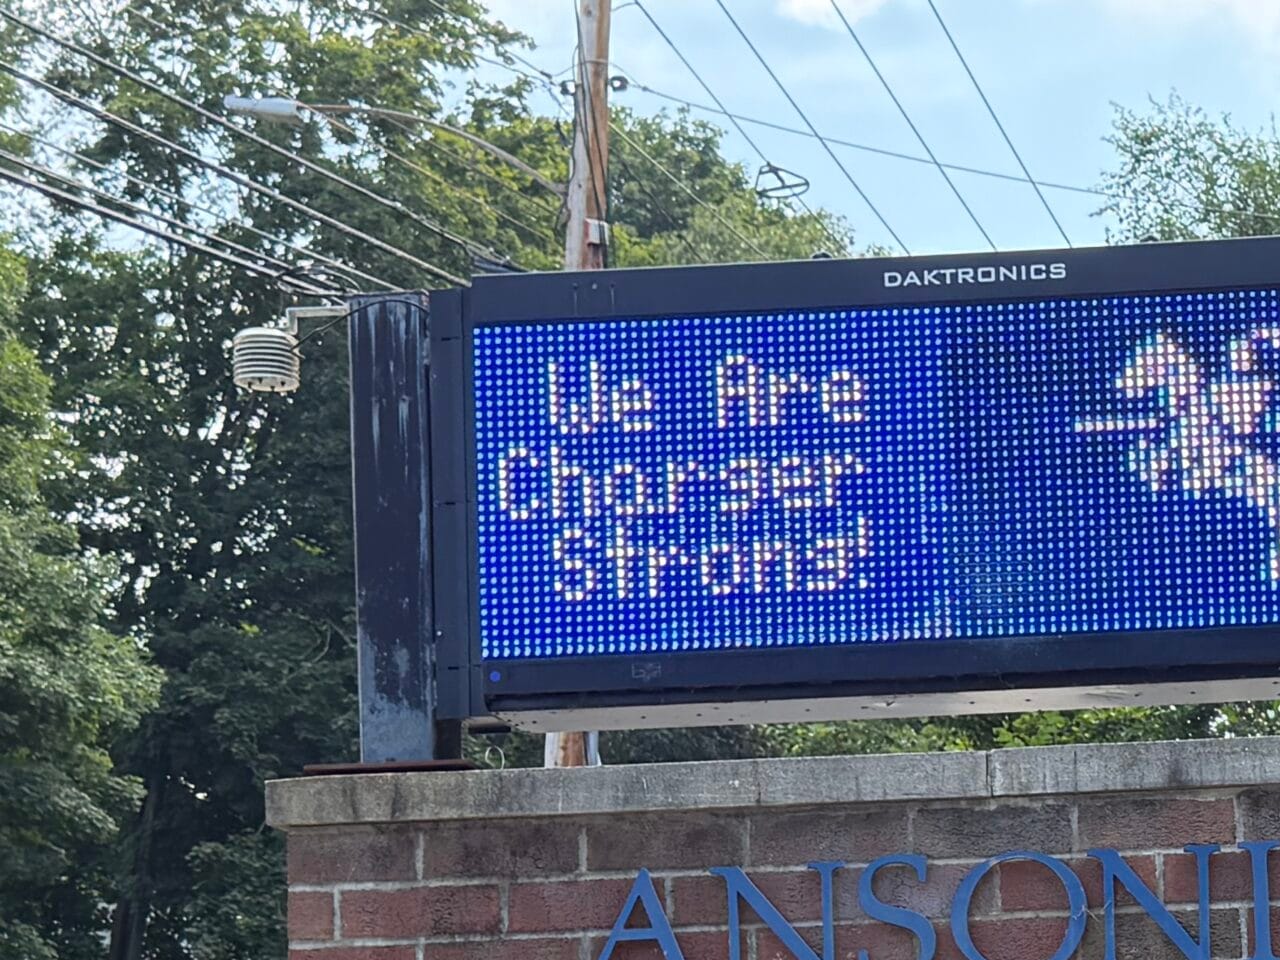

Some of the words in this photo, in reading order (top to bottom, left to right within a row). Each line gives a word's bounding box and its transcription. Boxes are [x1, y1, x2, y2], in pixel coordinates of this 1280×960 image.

[883, 262, 1068, 289] DAKTRONICS
[549, 360, 654, 435] We
[714, 354, 867, 428] Are
